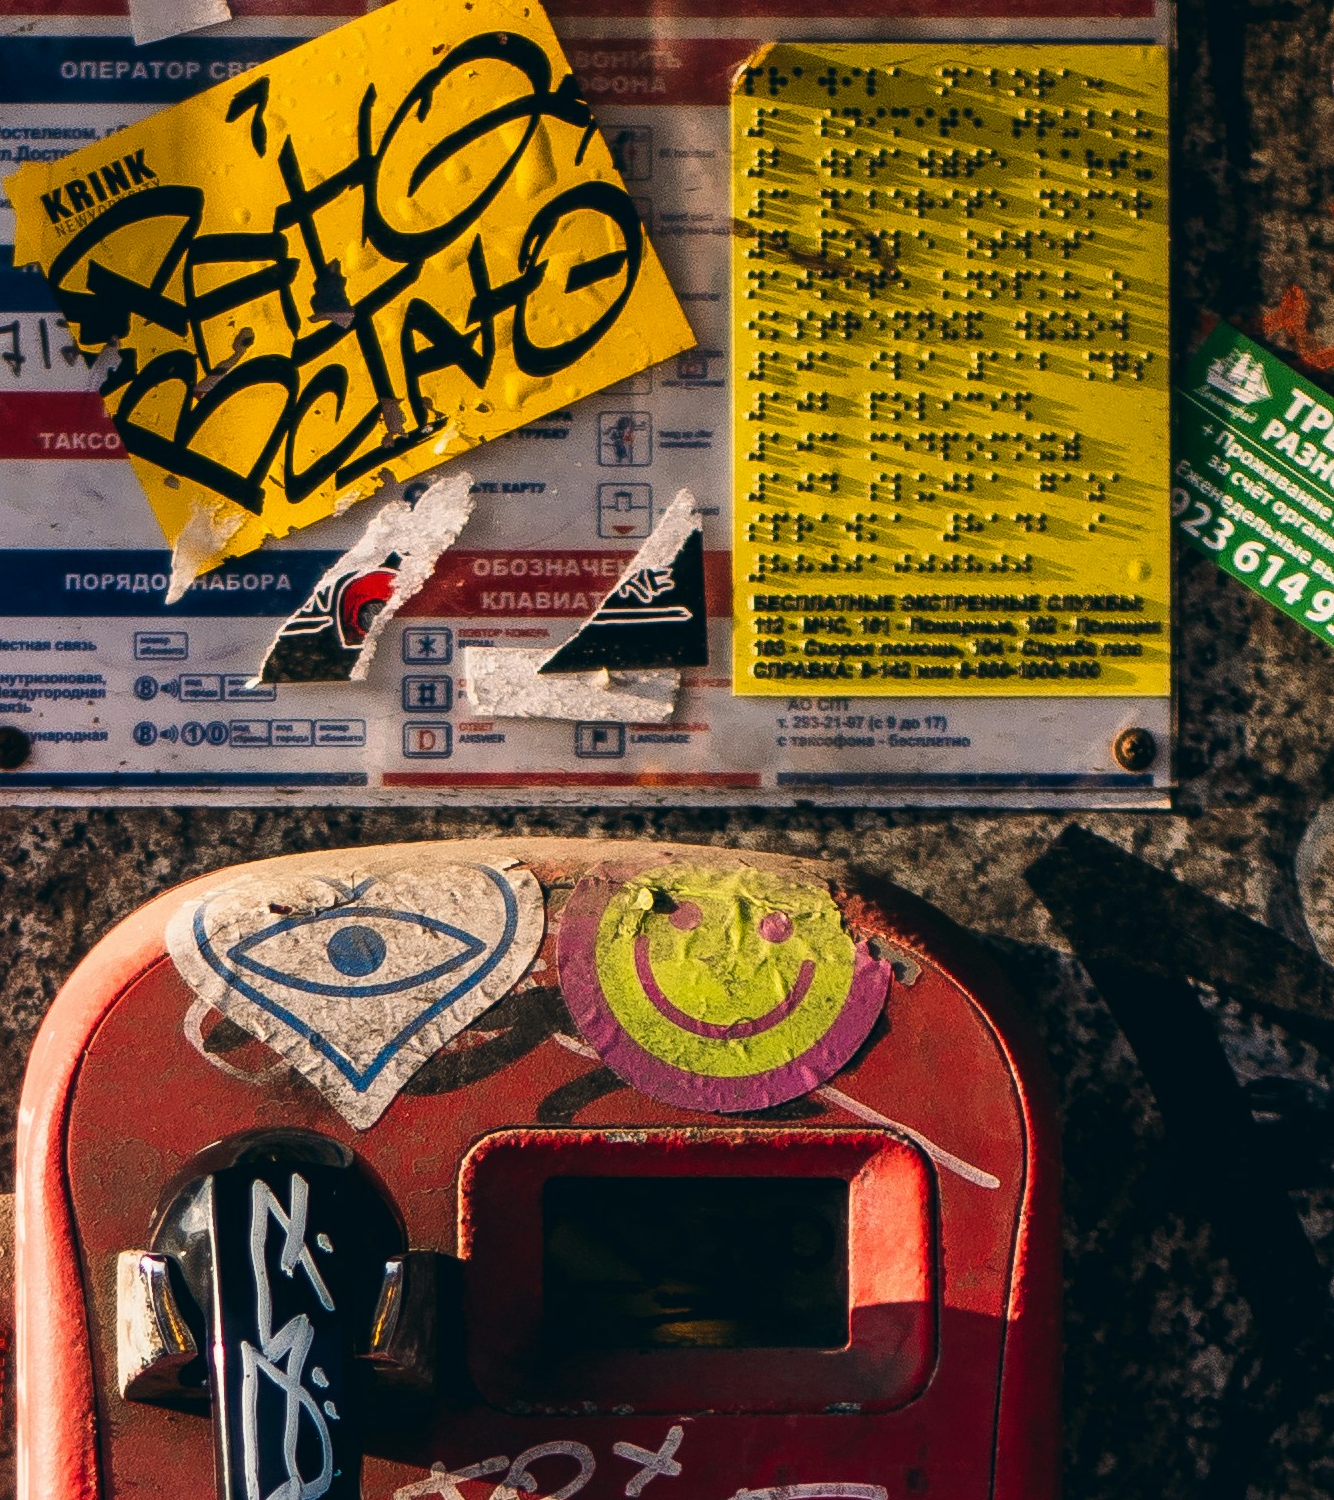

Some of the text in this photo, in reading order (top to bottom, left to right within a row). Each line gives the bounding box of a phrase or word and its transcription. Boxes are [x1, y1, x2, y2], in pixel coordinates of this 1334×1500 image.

[60, 59, 202, 81] ОПЕРАТОР
[575, 50, 684, 70] ВОНИТЬ
[41, 148, 158, 225] KRINK
[38, 432, 121, 450] ТАКСО
[1207, 454, 1230, 476] за
[1229, 469, 1271, 514] счёт
[1214, 428, 1332, 521] Проживание
[1175, 459, 1313, 567] Еженедельные
[473, 558, 630, 577] ОБОЗНАЧЕ
[1233, 541, 1304, 606] 614
[65, 573, 169, 594] ПОРЯДО
[481, 591, 605, 611] КЛАВИАТ
[55, 641, 98, 652] связь
[28, 730, 109, 745] ународная
